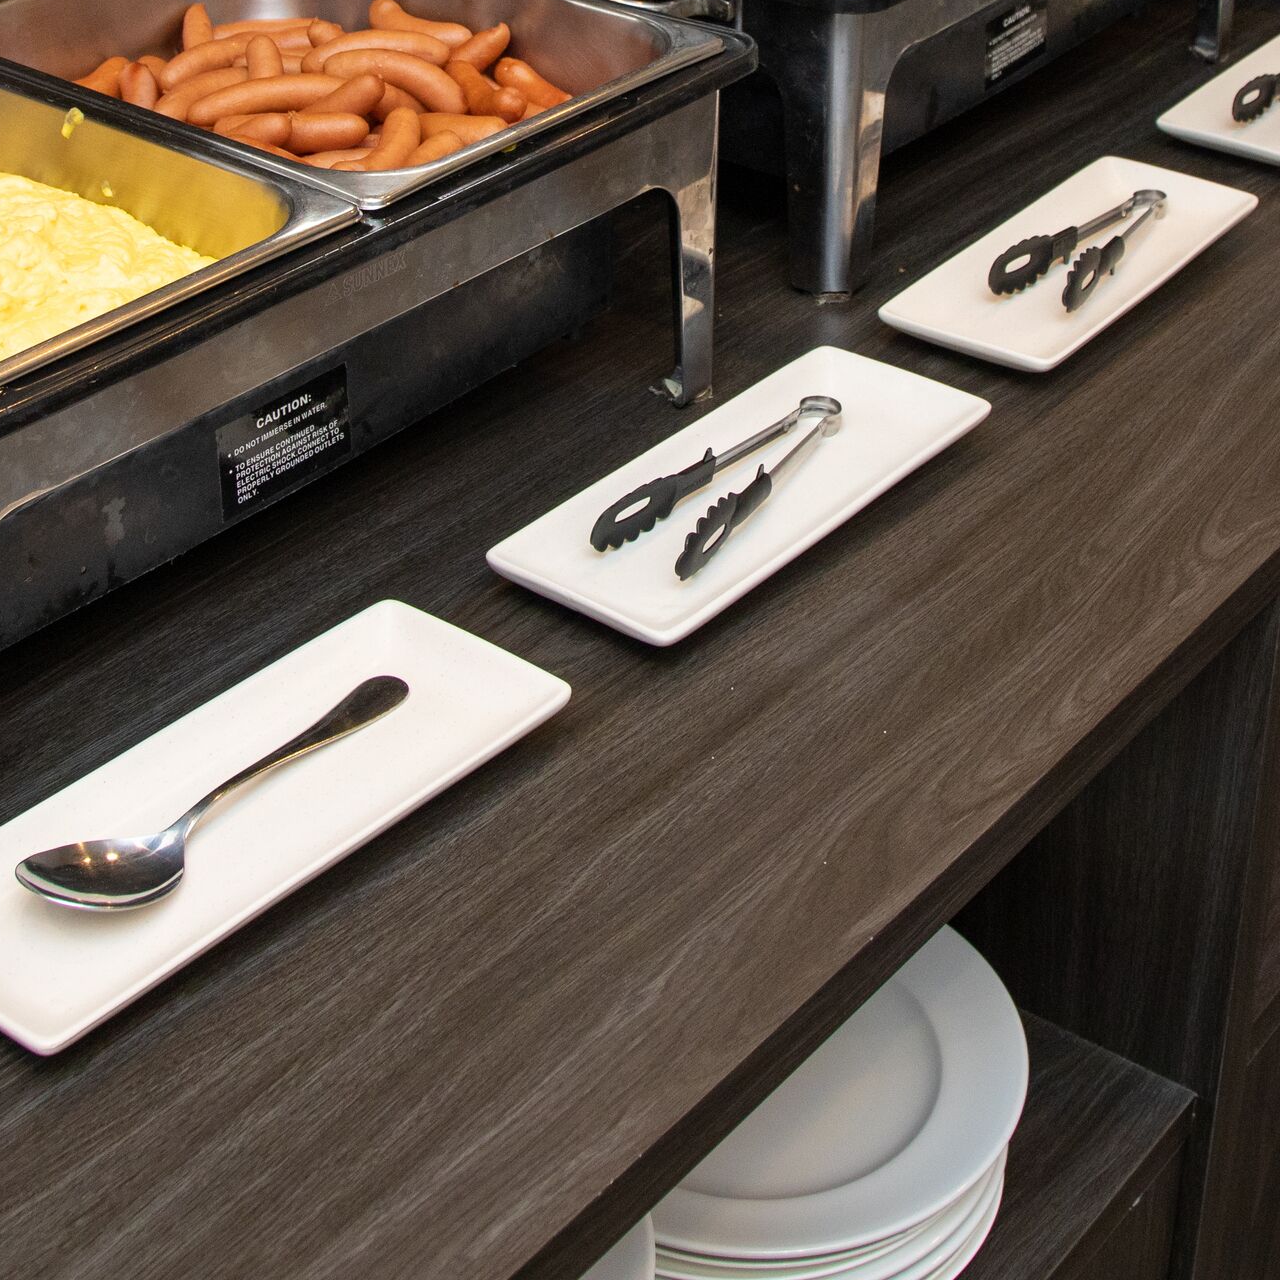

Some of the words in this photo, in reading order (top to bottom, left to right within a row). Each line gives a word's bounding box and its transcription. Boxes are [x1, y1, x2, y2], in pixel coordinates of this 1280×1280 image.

[343, 250, 407, 297] SUNNEX
[234, 445, 245, 457] DO
[245, 436, 260, 450] NOT
[261, 419, 292, 442] IMMERSE
[293, 415, 301, 425] IN
[301, 402, 327, 420] WATER.
[256, 393, 312, 429] CAUTION:
[235, 462, 246, 472] TO
[246, 446, 275, 467] ENSURE
[275, 424, 315, 451] CONTINUED
[236, 451, 281, 481] PROTECTION
[281, 434, 312, 456] AGAINST
[312, 425, 328, 439] RISK
[328, 419, 338, 430] OF
[236, 464, 271, 489] ELECTRIC
[297, 433, 329, 456] CONNECT
[330, 427, 340, 437] TO
[237, 470, 275, 497] PROPERLY
[275, 449, 314, 476] GROUNDED
[314, 432, 345, 454] OUTLETS
[237, 488, 260, 504] ONLY.
